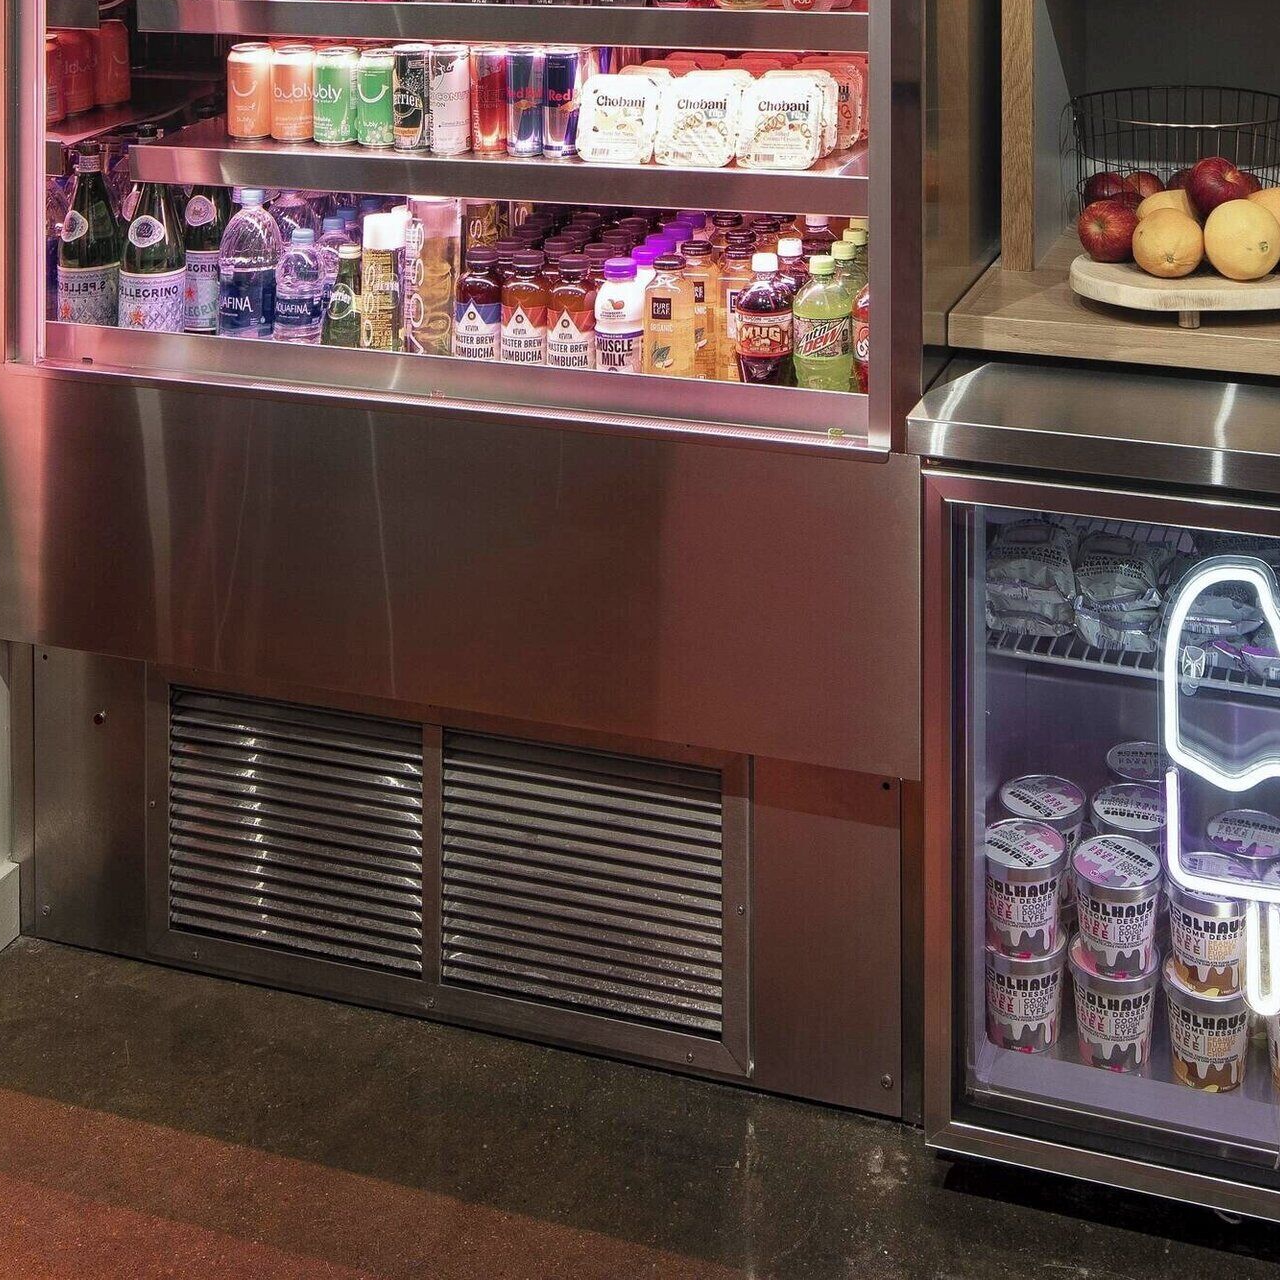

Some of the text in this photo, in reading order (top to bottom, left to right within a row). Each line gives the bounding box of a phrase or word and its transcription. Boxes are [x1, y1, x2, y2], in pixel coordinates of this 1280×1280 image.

[596, 94, 646, 109] Chobani
[676, 97, 727, 111] Chobani
[742, 326, 781, 342] MUG
[597, 339, 634, 353] MUSCLE
[601, 353, 625, 366] MILK
[1023, 1001, 1049, 1011] DOUGH
[1023, 1007, 1046, 1016] LYFE
